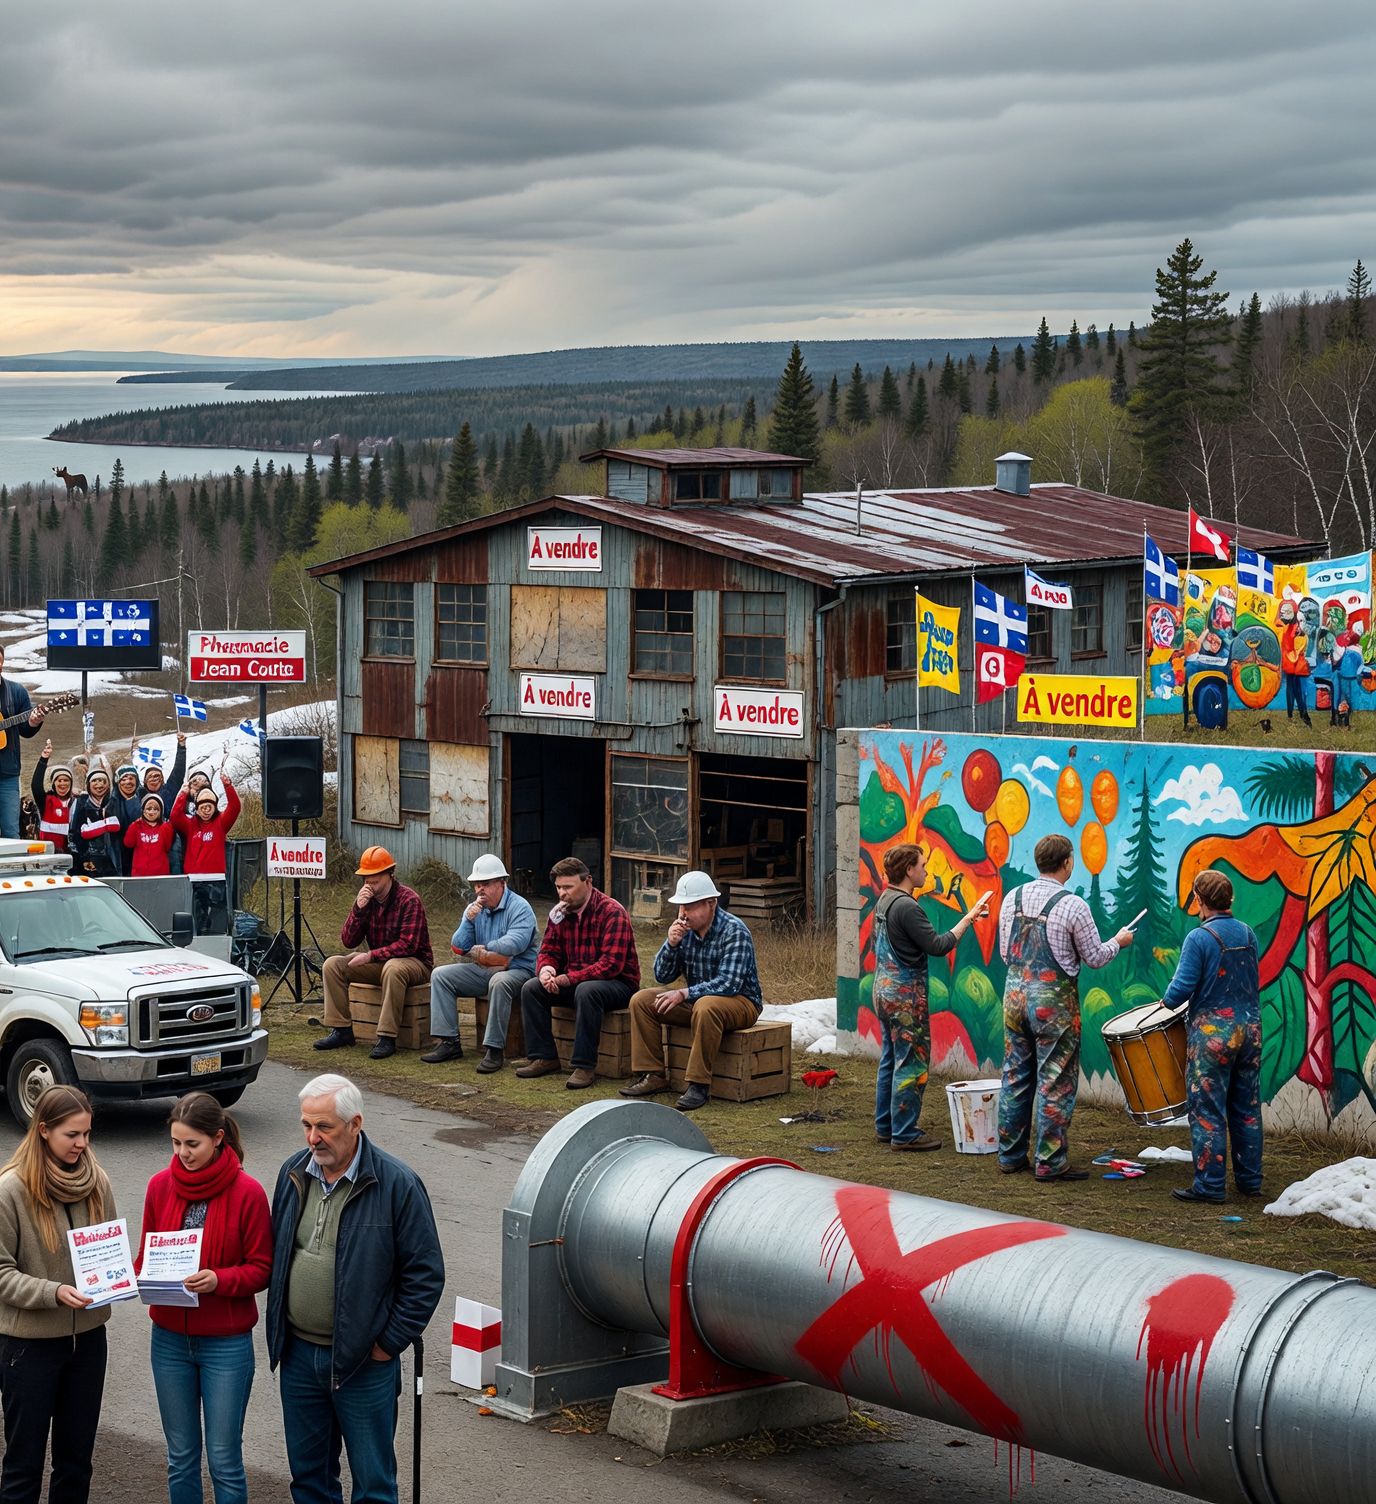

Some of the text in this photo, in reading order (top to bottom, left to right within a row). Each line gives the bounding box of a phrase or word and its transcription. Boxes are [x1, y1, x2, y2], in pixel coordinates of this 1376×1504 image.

[545, 533, 598, 559] vendre
[539, 681, 592, 708] vendre
[719, 693, 799, 725] À vendre
[1023, 677, 1132, 718] À vendre
